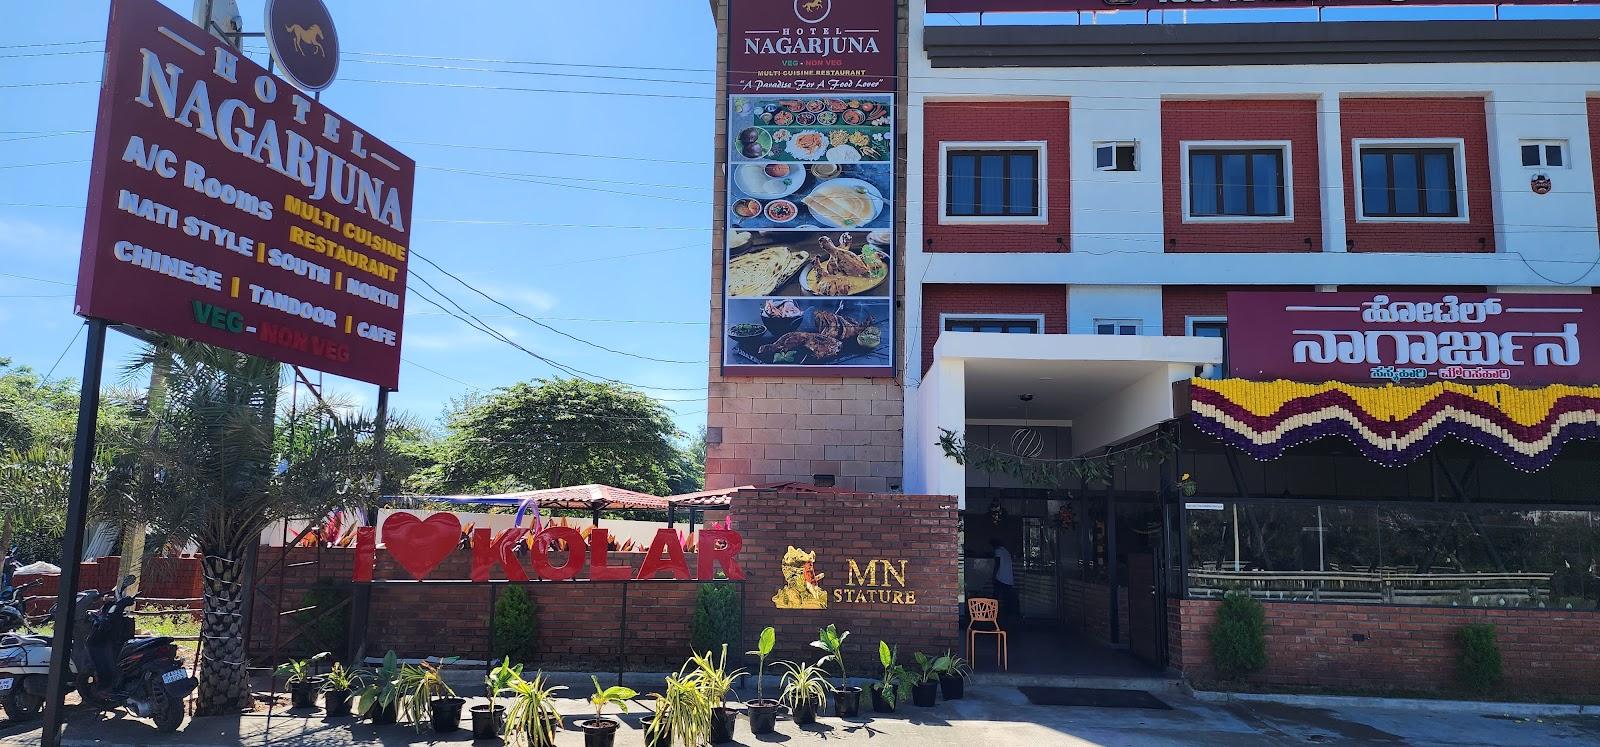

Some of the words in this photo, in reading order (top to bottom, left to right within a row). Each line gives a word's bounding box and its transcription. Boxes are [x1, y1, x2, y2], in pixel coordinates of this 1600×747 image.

[744, 37, 880, 56] NAGARJUNA
[782, 28, 842, 36] HOTEL
[213, 47, 367, 159] HOTEL
[754, 80, 792, 91] Paradise
[794, 80, 814, 91] For
[815, 79, 825, 90] A
[827, 79, 853, 90] Food
[122, 135, 177, 180] A/C
[135, 48, 405, 232] NAGARJUNA
[118, 189, 178, 229] NATI
[182, 216, 254, 257] STYLE
[268, 248, 331, 285] SOUTH
[346, 277, 399, 309] NORTH
[284, 194, 340, 232] MULTI
[343, 222, 406, 262] CUISINE
[289, 225, 398, 282] RESTAURANT
[114, 240, 222, 290] CHINESE
[249, 284, 337, 328] TANDOOR
[357, 321, 397, 346] CAFE
[1362, 294, 1502, 323] ಹೋಟೆಲ್
[192, 300, 243, 333] VEG
[258, 321, 309, 351] NON
[311, 335, 350, 362] VEG
[1292, 323, 1581, 366] ನಾಗಾರ್ಜುನ
[352, 526, 376, 582] I
[472, 527, 746, 582] KOLAR
[846, 558, 908, 587] MN
[833, 589, 917, 605] STATURE
